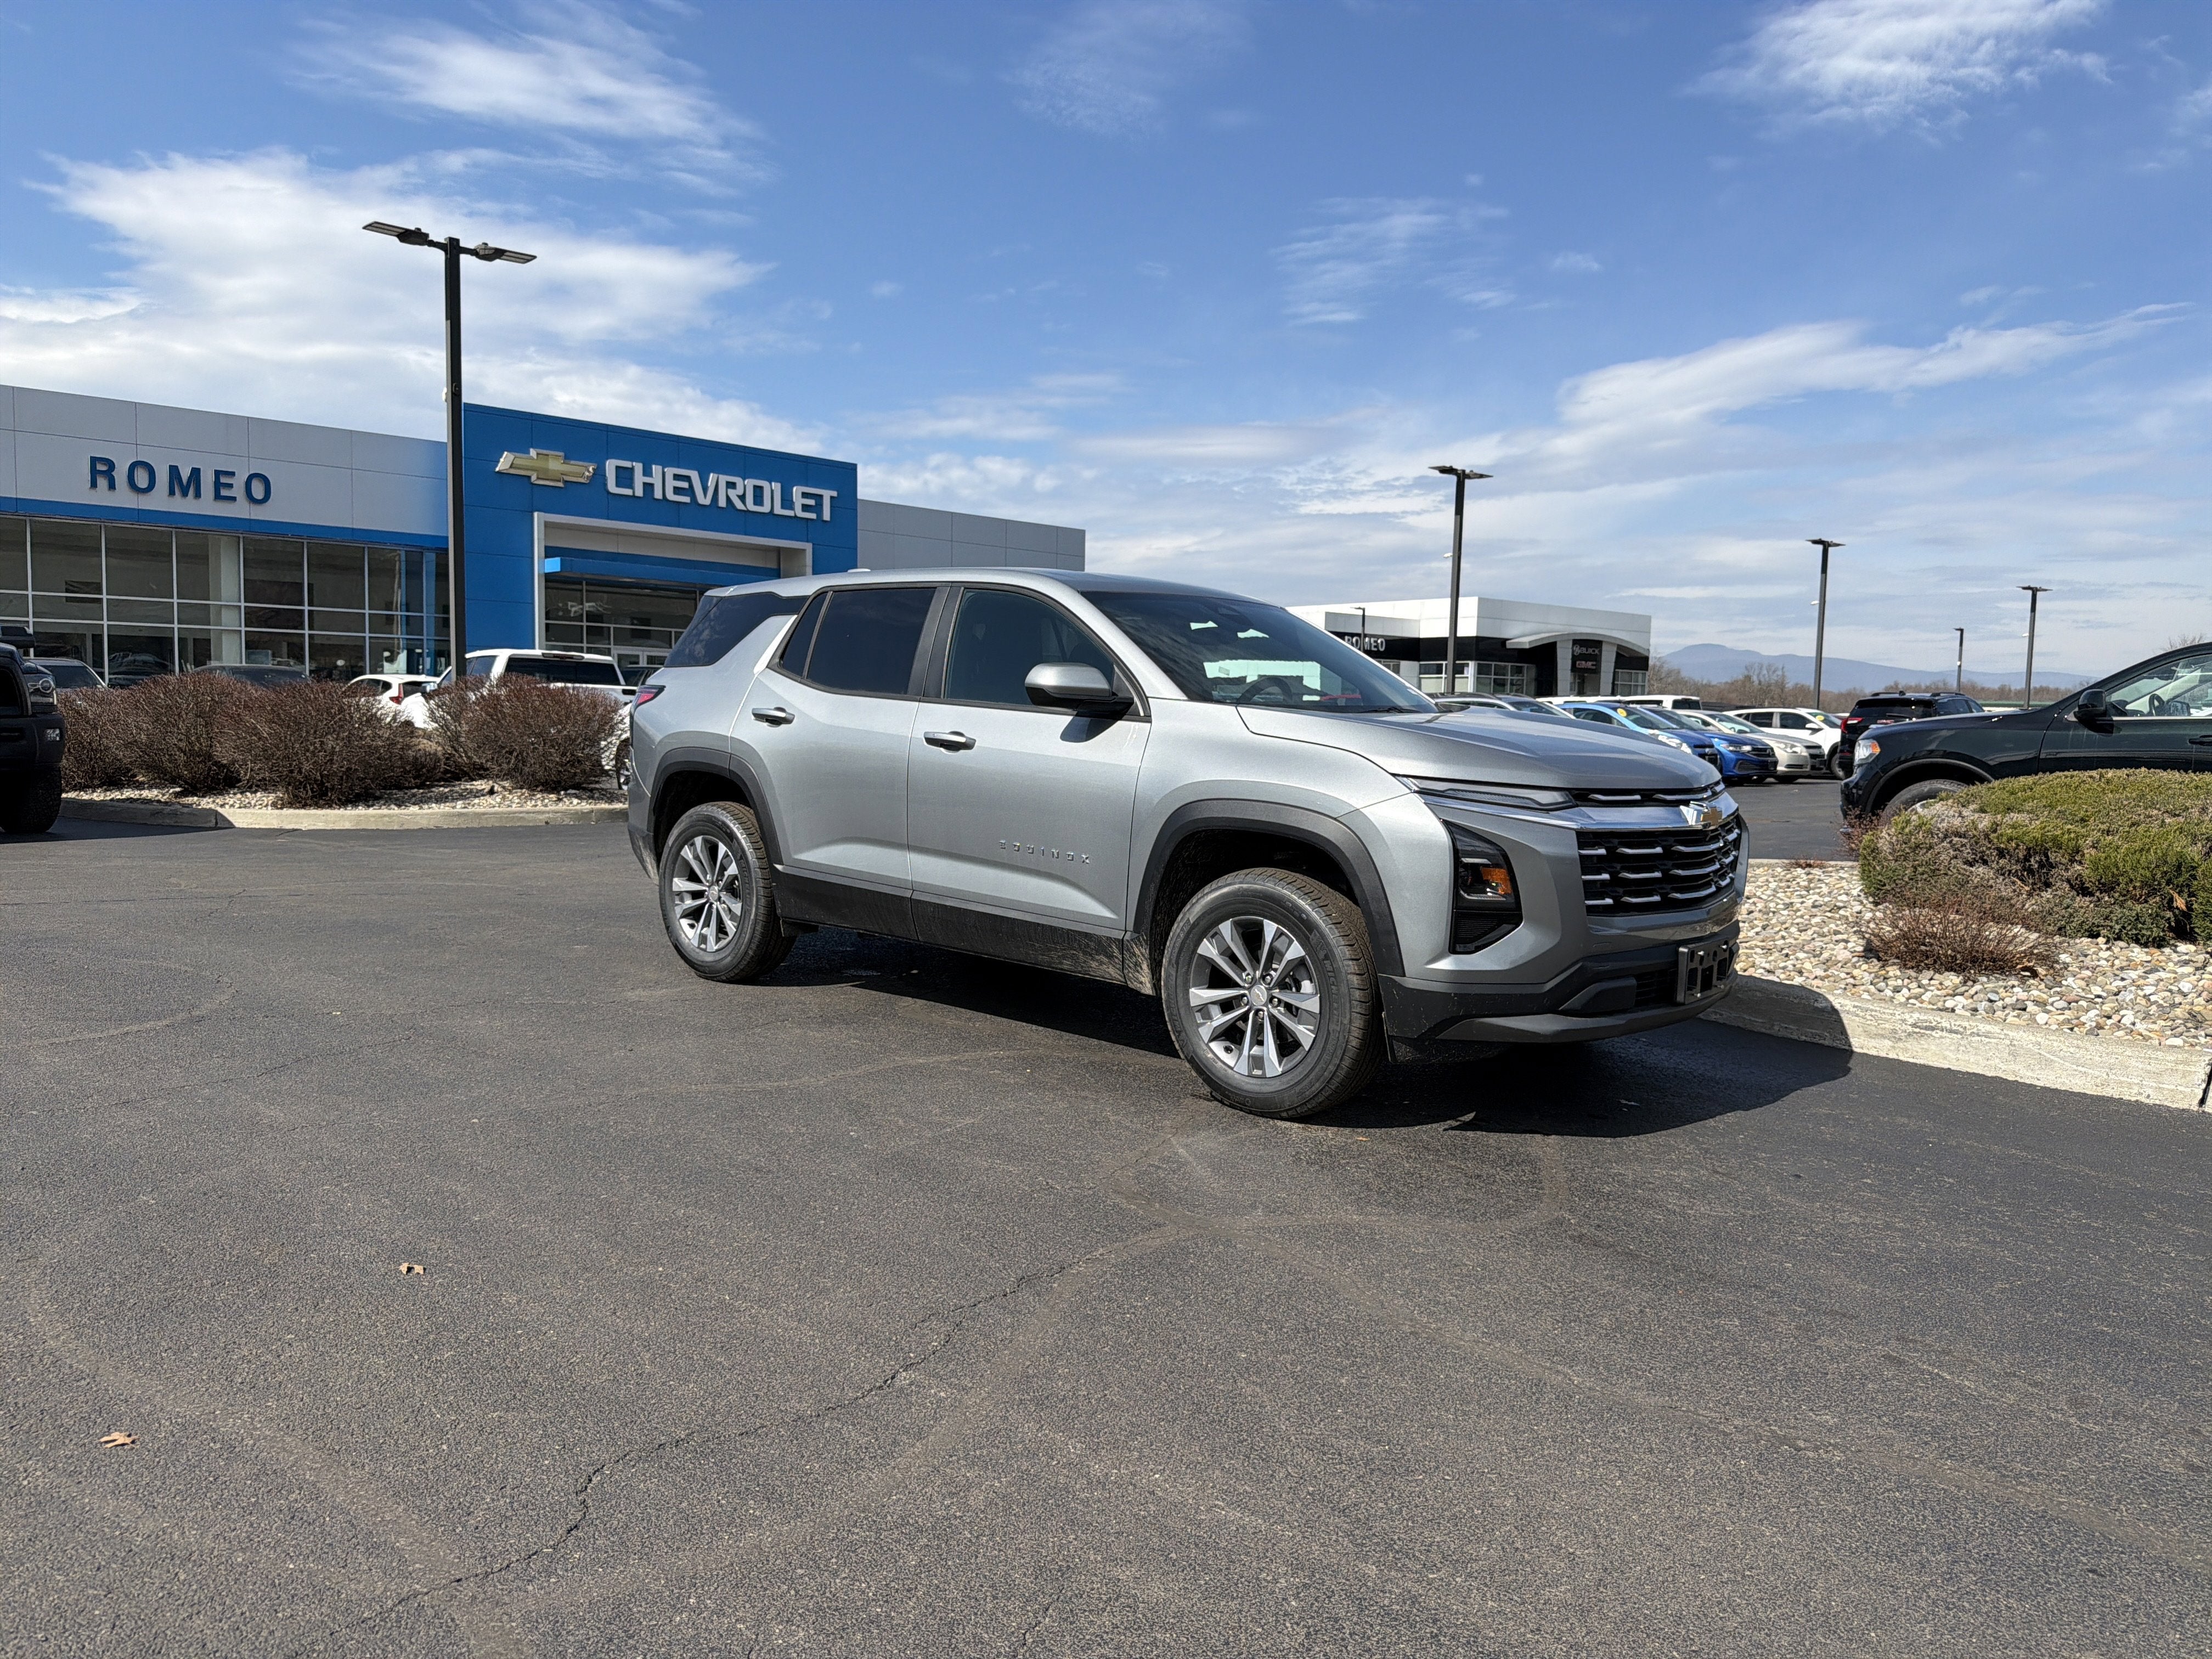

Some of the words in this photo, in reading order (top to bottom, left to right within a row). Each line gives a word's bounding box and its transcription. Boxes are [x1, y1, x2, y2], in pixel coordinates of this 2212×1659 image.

[88, 455, 272, 504] ROMEO
[606, 459, 837, 521] CHEVROLET
[1345, 635, 1386, 651] ROMEO
[1576, 661, 1596, 669] GMC
[998, 839, 1090, 864] EQUINOX
